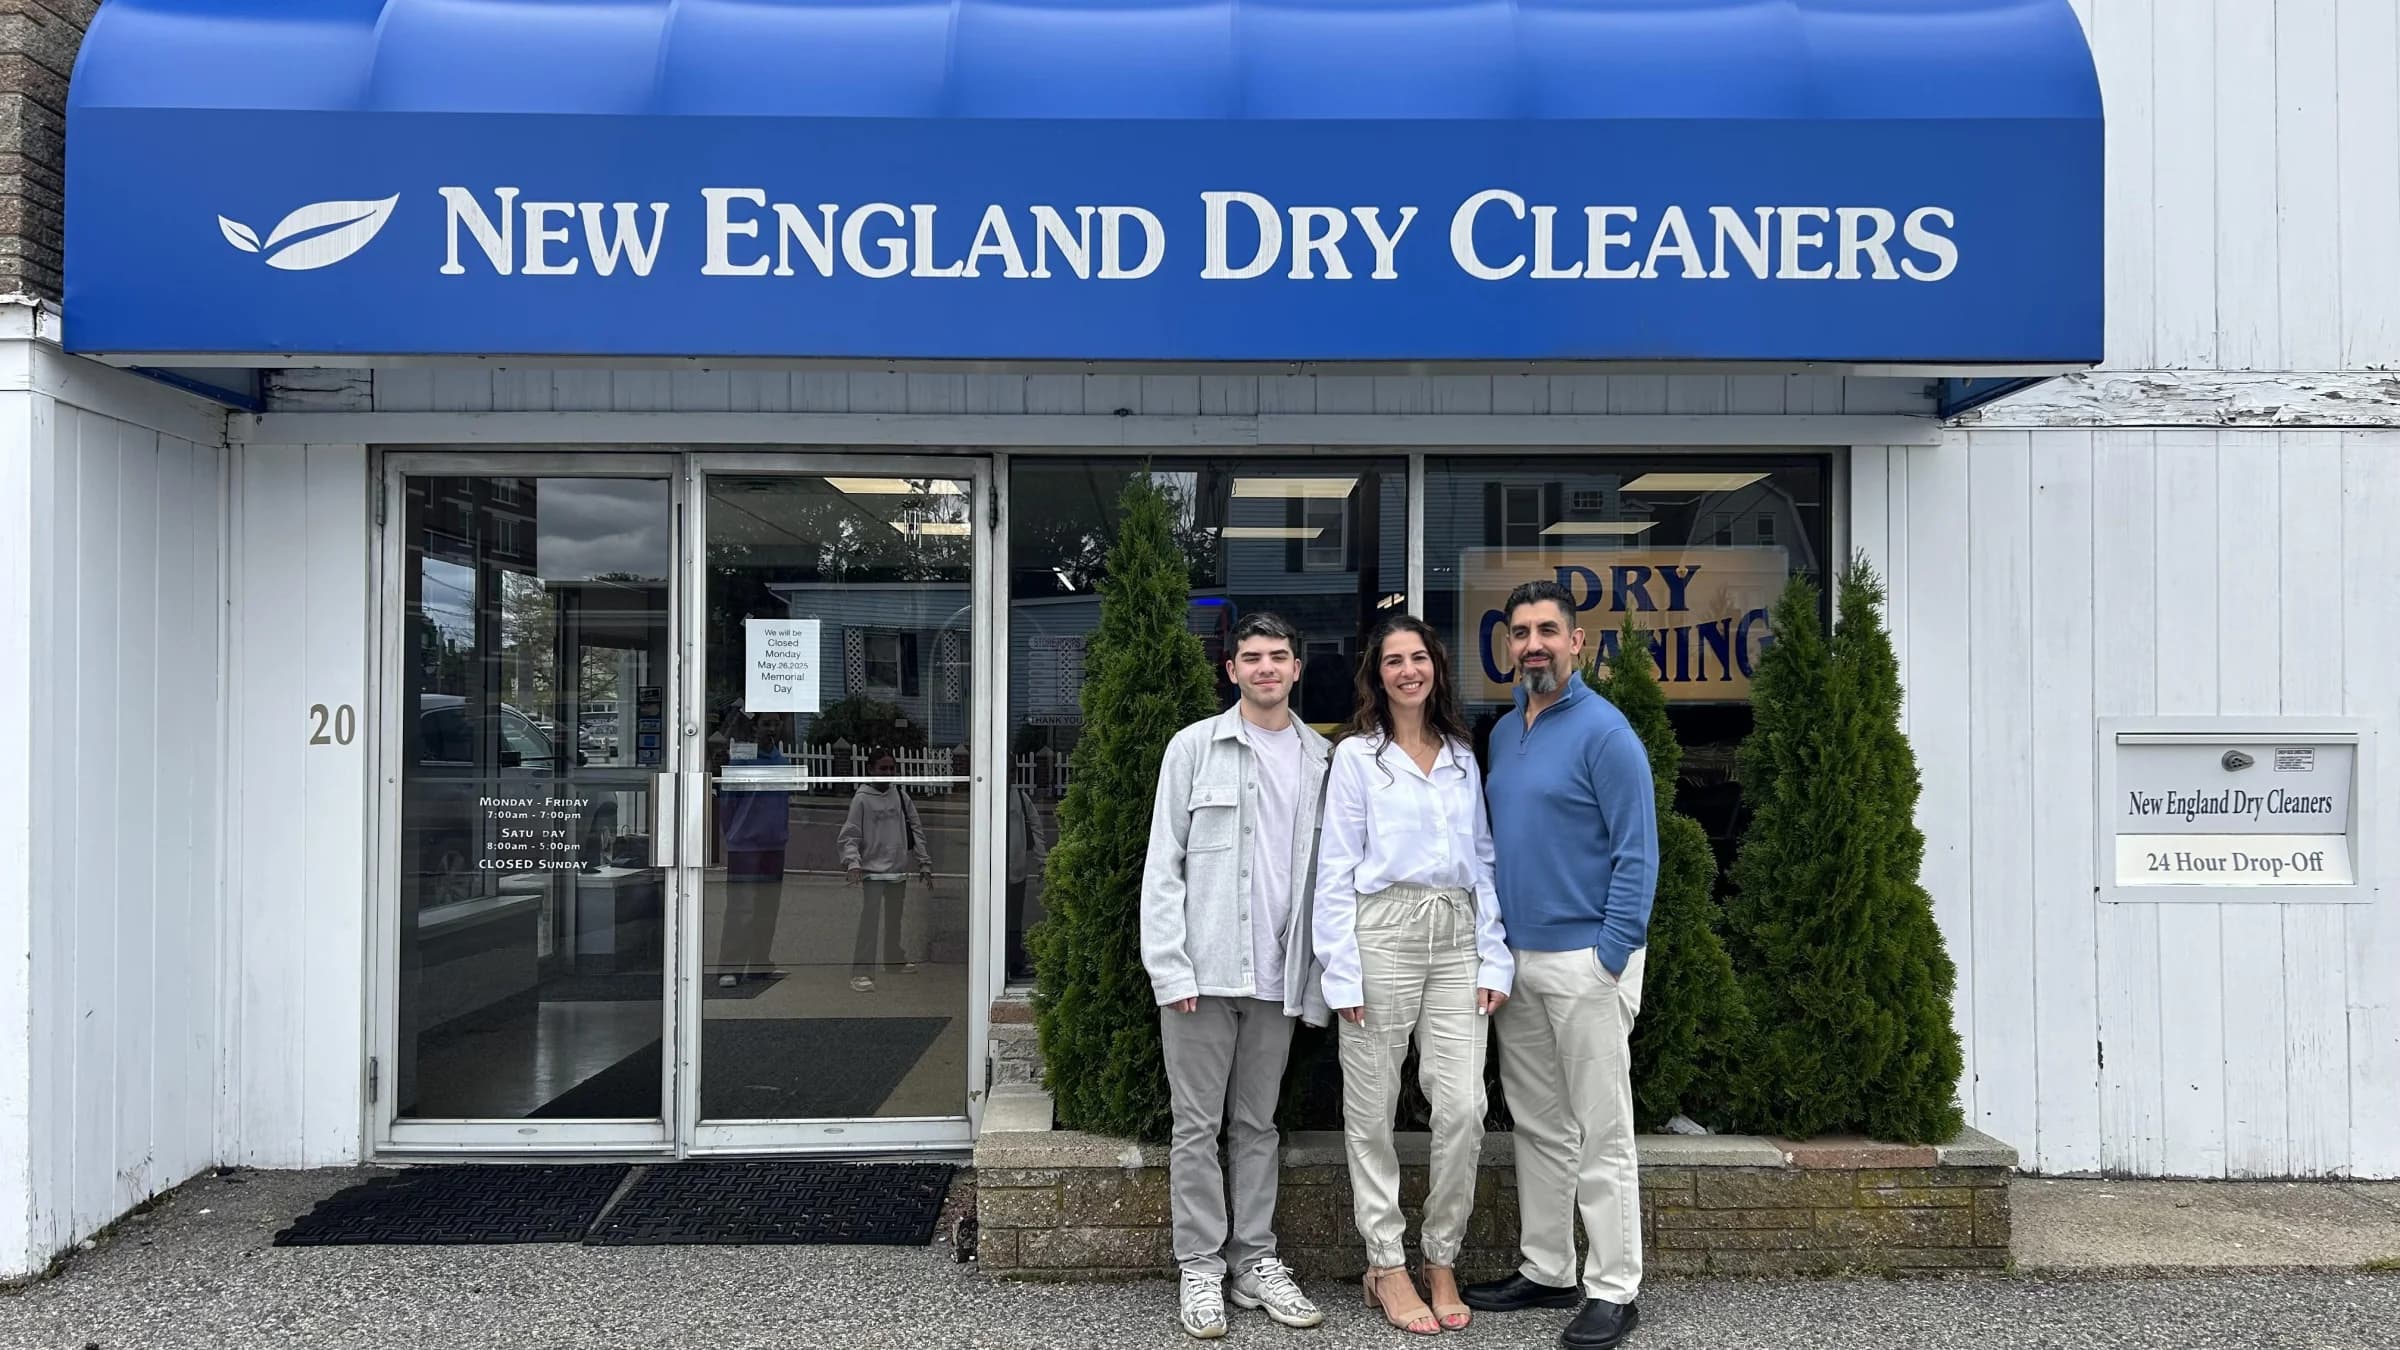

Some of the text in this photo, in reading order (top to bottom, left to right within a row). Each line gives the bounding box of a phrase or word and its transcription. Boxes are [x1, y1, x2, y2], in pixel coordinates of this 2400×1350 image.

[438, 186, 1959, 282] NEW ENGLAND DRY CLEANERS
[1553, 565, 1701, 612] DRY
[764, 629, 803, 637] We will be
[767, 638, 799, 647] Closed
[1479, 607, 1776, 684] CANING
[765, 650, 801, 660] Monday
[761, 672, 805, 681] Memorial
[773, 684, 793, 695] Day
[309, 703, 356, 746] 20
[1031, 716, 1062, 724] THANK
[479, 797, 534, 807] MONDAY
[545, 797, 589, 807] FRIDAY
[2129, 788, 2333, 823] New England Dry Cleaners
[487, 811, 528, 819] 7:00am
[540, 811, 581, 821] 7:00pm
[486, 842, 528, 850] 8:00am
[540, 842, 581, 852] 5:00pm
[478, 859, 588, 869] CLOSED SUNDAY
[2147, 851, 2324, 878] 24 Hour Drop-Off
